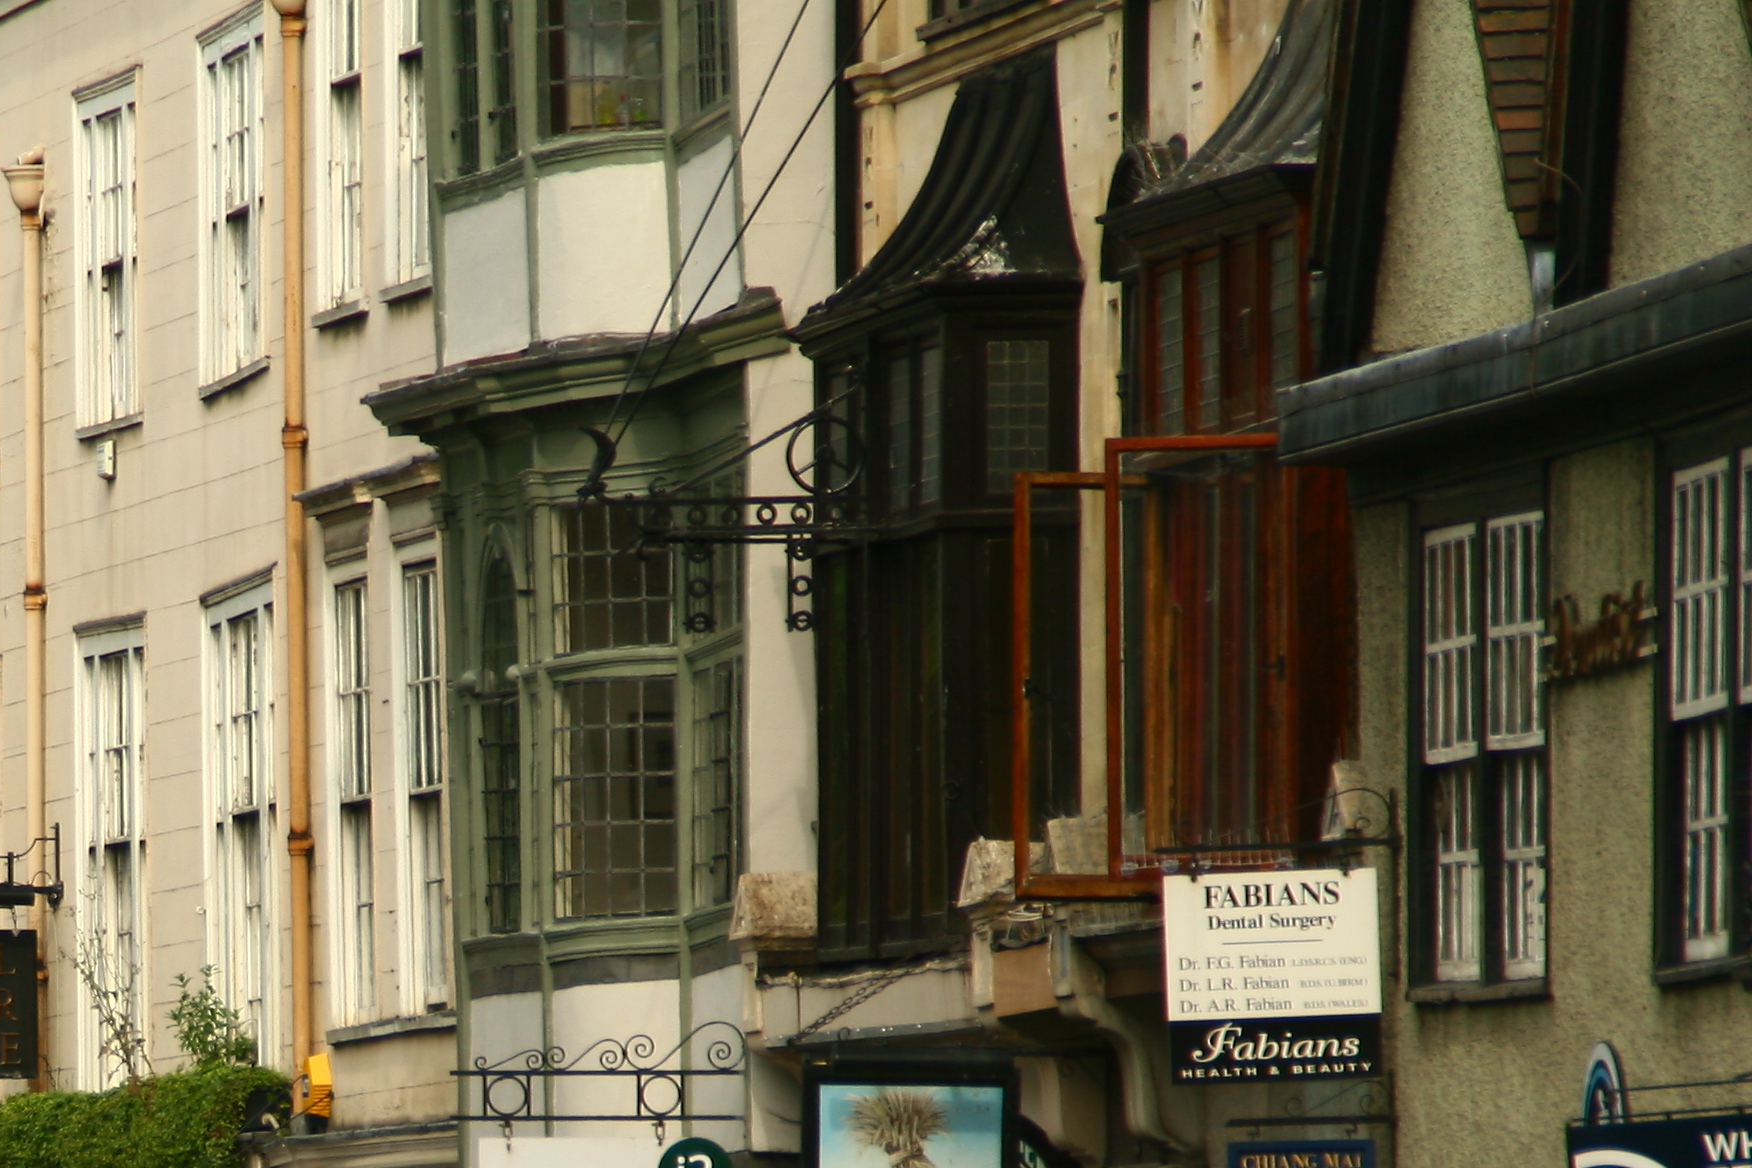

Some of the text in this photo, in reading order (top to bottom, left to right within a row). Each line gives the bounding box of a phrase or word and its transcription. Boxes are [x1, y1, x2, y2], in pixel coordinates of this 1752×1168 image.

[1204, 881, 1342, 909] FABIANS
[1208, 912, 1336, 930] Dental Surgery
[1178, 957, 1201, 971] Dr.
[1240, 955, 1286, 969] Fabian
[1179, 978, 1202, 992] Dr.
[1243, 976, 1289, 990] Fabian
[1181, 1000, 1202, 1014] Dr.
[1246, 997, 1292, 1012] Fabian
[1191, 1022, 1360, 1063] Fabians
[1182, 1062, 1372, 1079] HEALTH & BEAUTY
[1322, 1153, 1363, 1168] MAI
